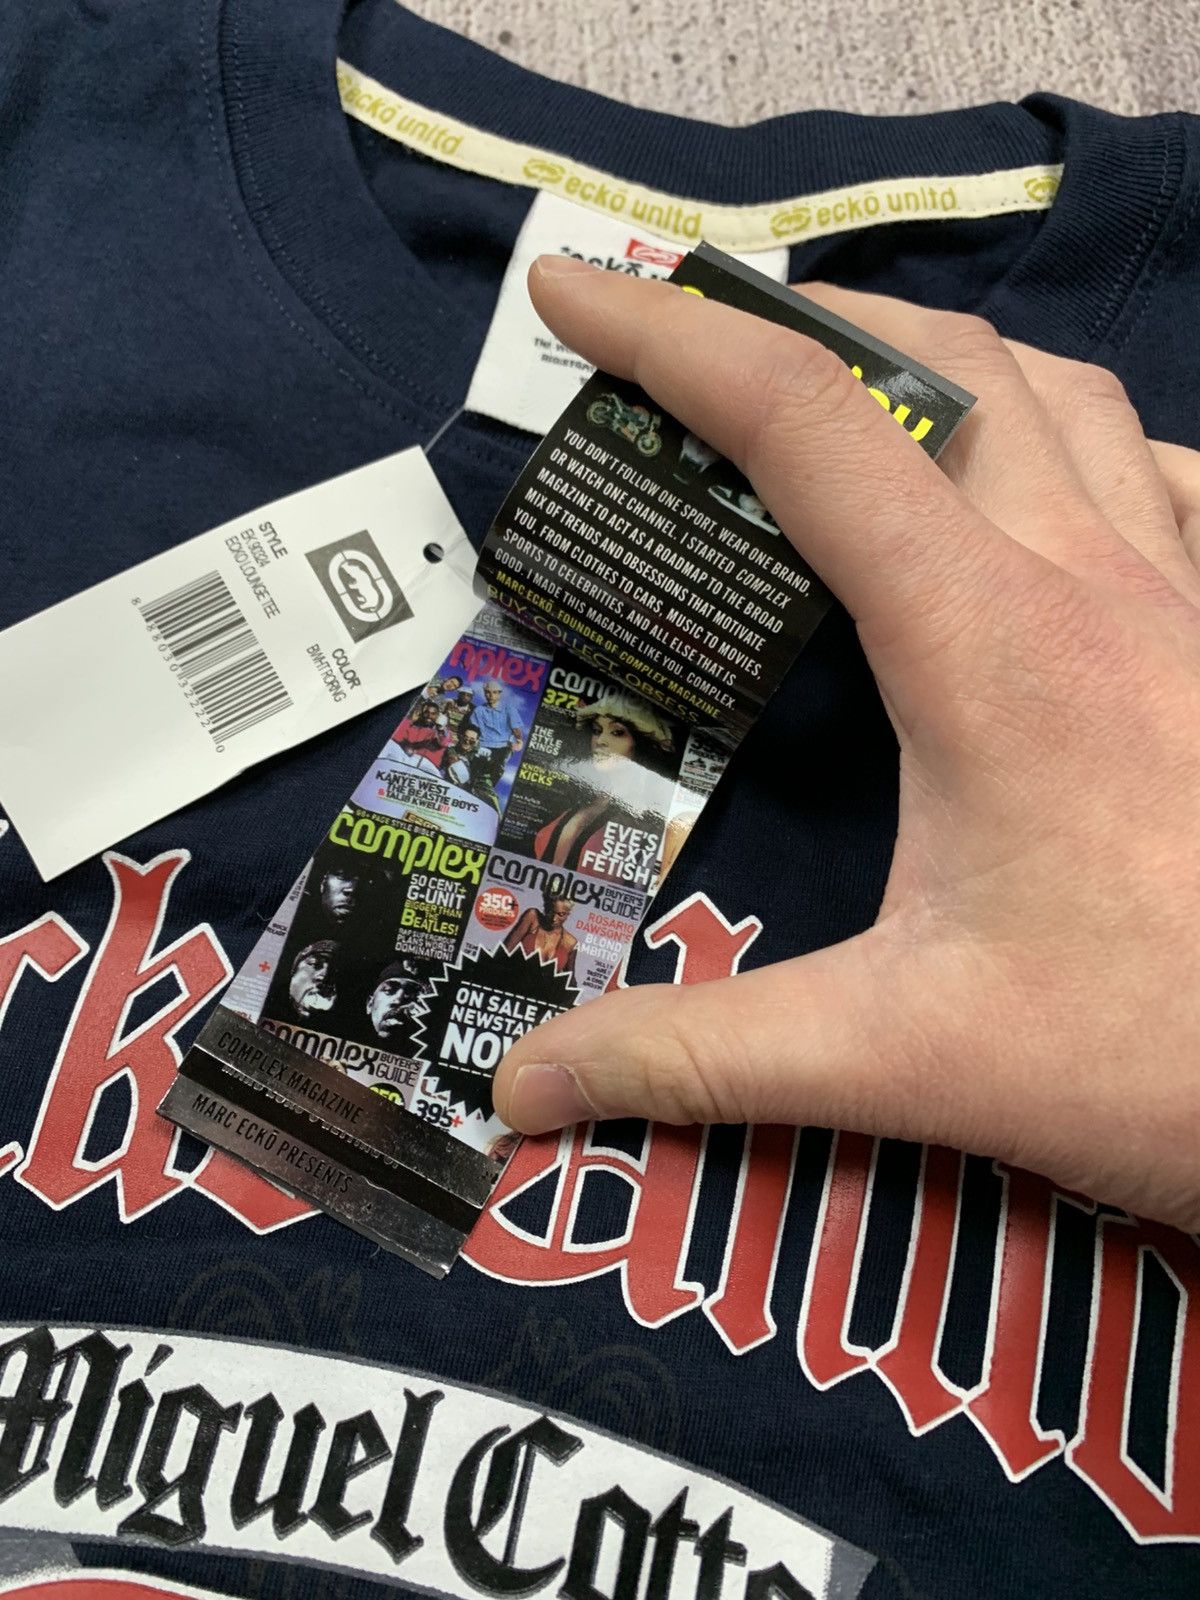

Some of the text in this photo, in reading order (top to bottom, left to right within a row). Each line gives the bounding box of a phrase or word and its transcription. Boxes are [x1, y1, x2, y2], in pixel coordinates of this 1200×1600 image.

[396, 114, 463, 155] unltd
[886, 187, 958, 213] unltd
[631, 198, 701, 239] unltd
[562, 428, 815, 596] YOU DON'T FOLLOW ONE SPORT, WEAR ONE BRAND,
[258, 519, 288, 559] STYLE
[548, 447, 792, 611] OR WATCH ONE CHANNEL. I STARTED COMPLEX
[535, 467, 784, 634] MAGAZINE TO ACT AS A ROADMAP TO THE BROAD
[523, 486, 766, 652] MIX OF TRENDS AND OBSESSIONS THAT MOTIVATE
[259, 596, 280, 620] TEE
[501, 527, 737, 686] SPORTS TO CELEBRITIES, AND ALL ELSE THAT IS
[511, 507, 766, 680] YOU, FROM CLOTHES TO CARS, MUSIC TO MOVIES,
[492, 547, 527, 576] GOOD.
[524, 567, 534, 580] I
[531, 571, 563, 599] MADE
[560, 590, 587, 614] THIS
[584, 605, 639, 647] MAGAZINE
[636, 638, 663, 662] LIKE
[660, 653, 687, 678] YOU.
[685, 669, 739, 711] COMPLEX.
[494, 570, 526, 596] MARC
[556, 609, 605, 646] FOUNDER
[603, 638, 619, 655] OF
[618, 648, 668, 686] COMPLEX
[666, 678, 722, 719] MAGAZINE
[330, 646, 361, 690] COLOR
[542, 688, 579, 710] 377
[530, 732, 562, 748] STYLE
[532, 724, 554, 737] THE
[527, 740, 560, 756] KINGS
[375, 770, 416, 788] KANYE
[417, 779, 449, 796] WEST
[518, 769, 553, 786] KICKS
[386, 781, 479, 813] THE BEASTIE BOYS
[329, 811, 487, 885] complex
[599, 837, 654, 868] SEXY
[603, 820, 659, 853] EVE'S
[409, 872, 428, 887] 50
[580, 849, 650, 885] FETISH
[405, 883, 466, 910] G-UNIT
[437, 905, 463, 919] THAN
[600, 897, 641, 921] GUIDE
[587, 911, 635, 934] ROSARIO
[396, 933, 425, 946] PLANS
[584, 933, 622, 953] BLOND
[455, 986, 484, 1009] ON
[486, 994, 538, 1023] SALE
[216, 1029, 288, 1082] COMPLEX
[285, 1069, 364, 1125] MAGAZINE
[374, 1062, 418, 1087] GUIDE
[378, 1052, 420, 1071] BUYER'S
[191, 1092, 237, 1129] MARC
[275, 1140, 354, 1194] PRESENTS
[444, 1416, 815, 1600] Cott
